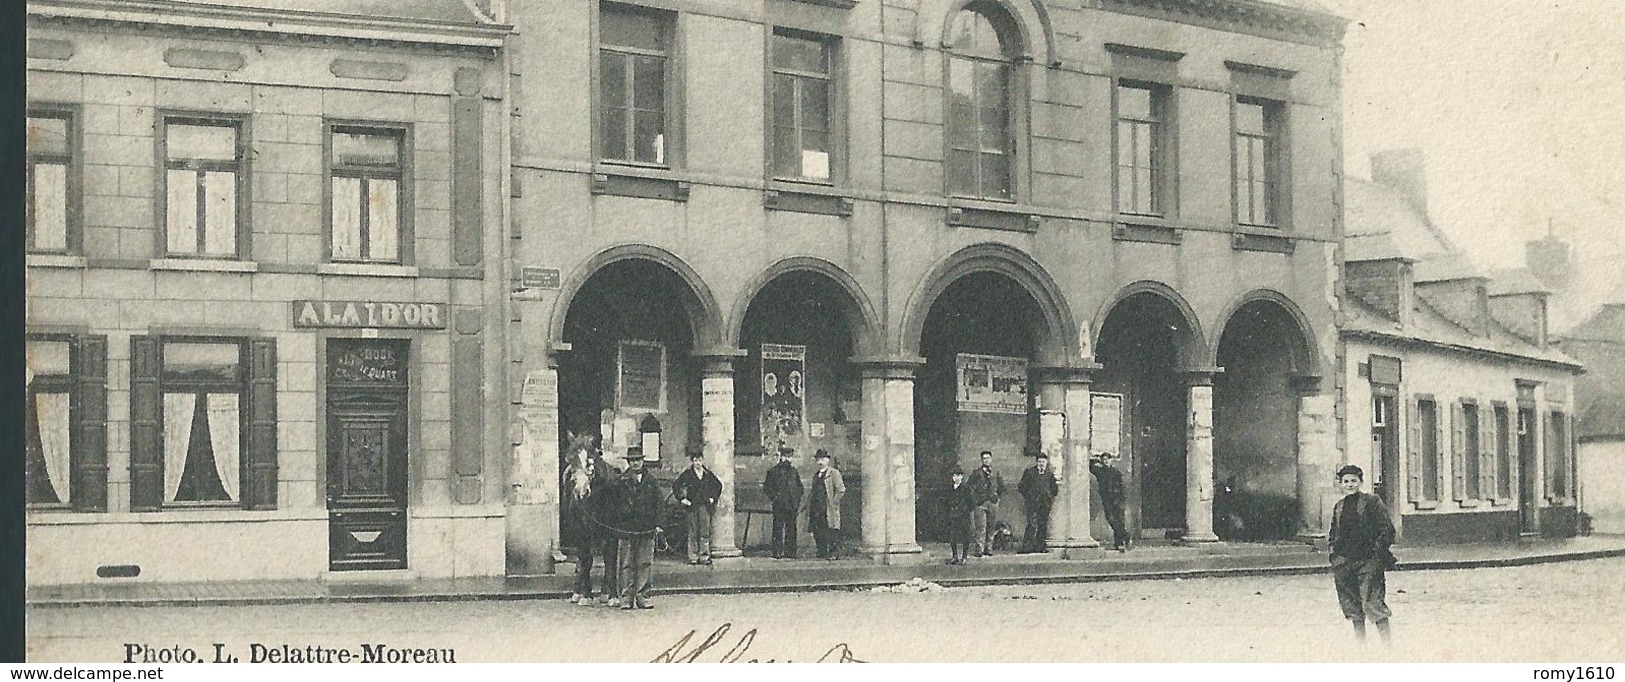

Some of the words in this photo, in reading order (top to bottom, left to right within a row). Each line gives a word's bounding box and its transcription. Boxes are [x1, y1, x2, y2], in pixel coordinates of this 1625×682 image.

[123, 643, 204, 663] Photo.
[212, 643, 239, 663] L.
[250, 643, 456, 663] Delattre-Moreau
